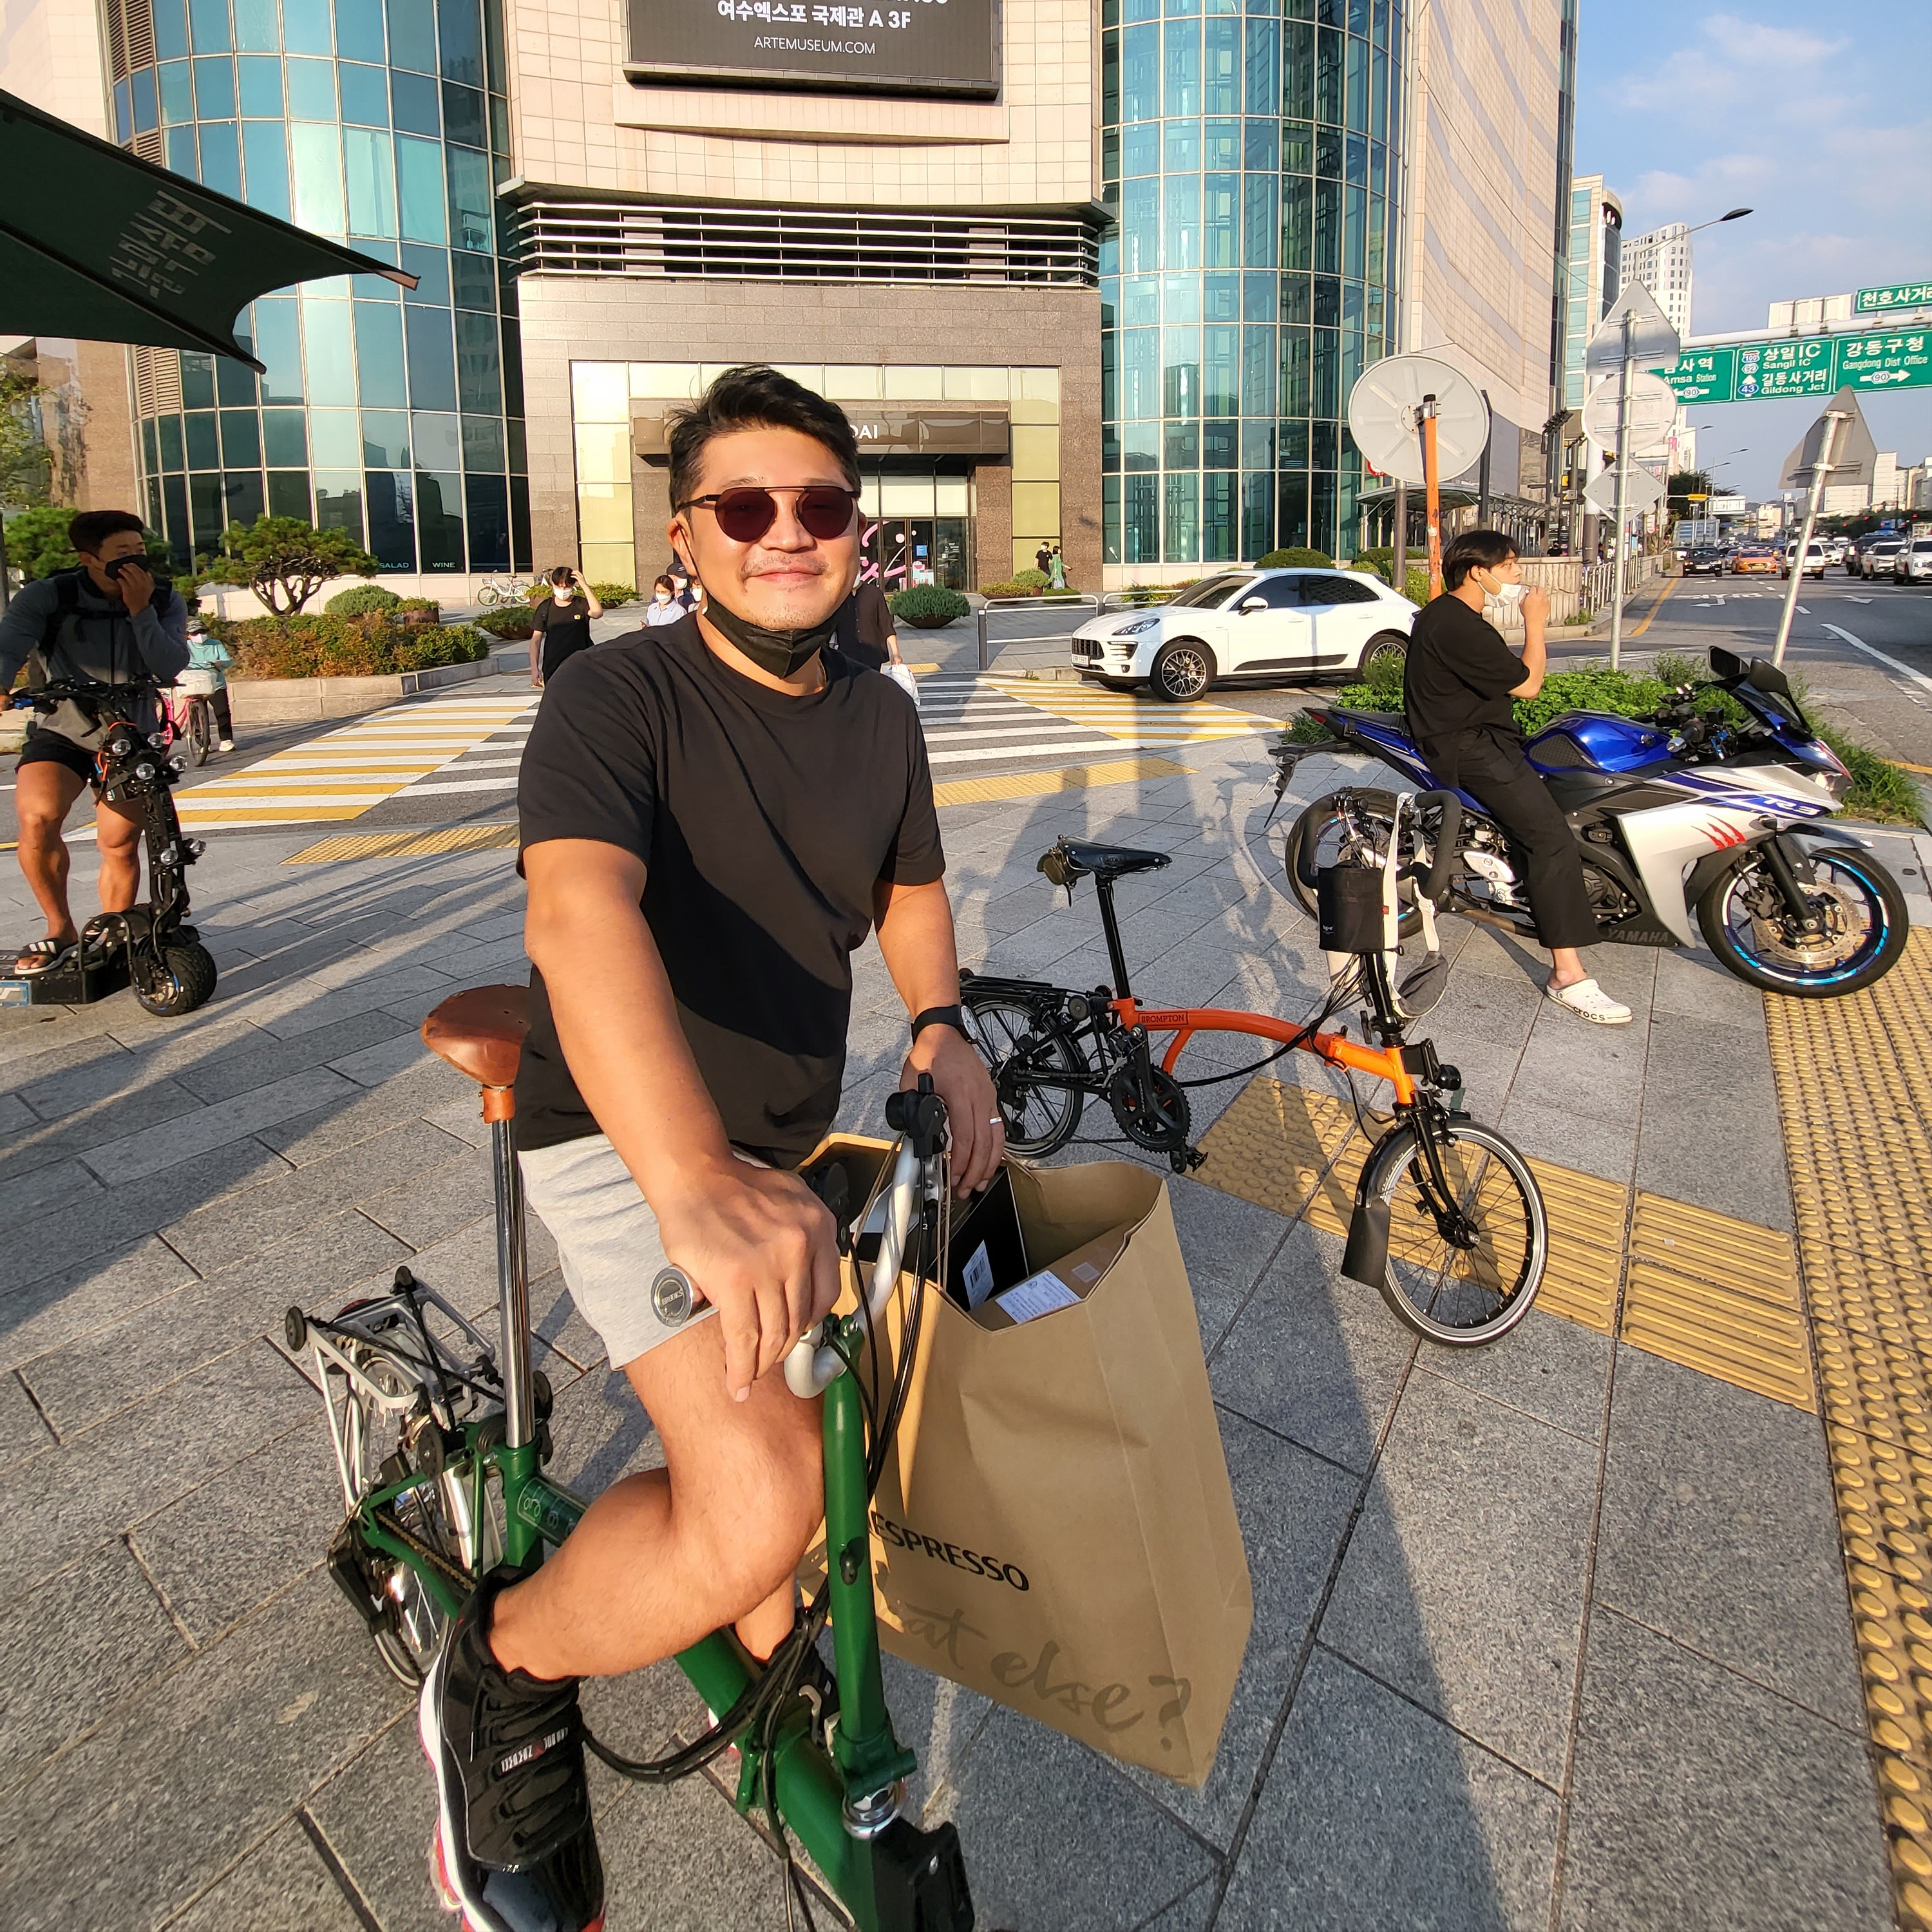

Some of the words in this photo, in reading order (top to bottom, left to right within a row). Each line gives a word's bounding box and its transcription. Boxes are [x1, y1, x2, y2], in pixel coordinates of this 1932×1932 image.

[717, 0, 808, 23] 여수엑스포
[811, 5, 864, 28] 국제관
[869, 10, 884, 28] A
[888, 11, 911, 29] 3F
[754, 36, 876, 55] ARTEMUSEUM.COM
[1846, 336, 1924, 357] 강동구청
[1763, 360, 1795, 369] Sangil
[1799, 358, 1811, 366] IC
[1842, 359, 1882, 370] Gangdong
[1884, 357, 1901, 367] Dist
[1904, 355, 1928, 366] Office
[1663, 375, 1692, 384] Amsa
[1696, 374, 1717, 383] Station
[1761, 368, 1828, 387] 길동사거리
[1608, 928, 1670, 943] YAMAHA
[1141, 1014, 1184, 1023] BROMPTON
[1573, 1006, 1605, 1021] crocs
[661, 1289, 684, 1305] BROOKS
[870, 1510, 1029, 1591] ESPRESSO
[990, 1640, 1192, 1752] else?
